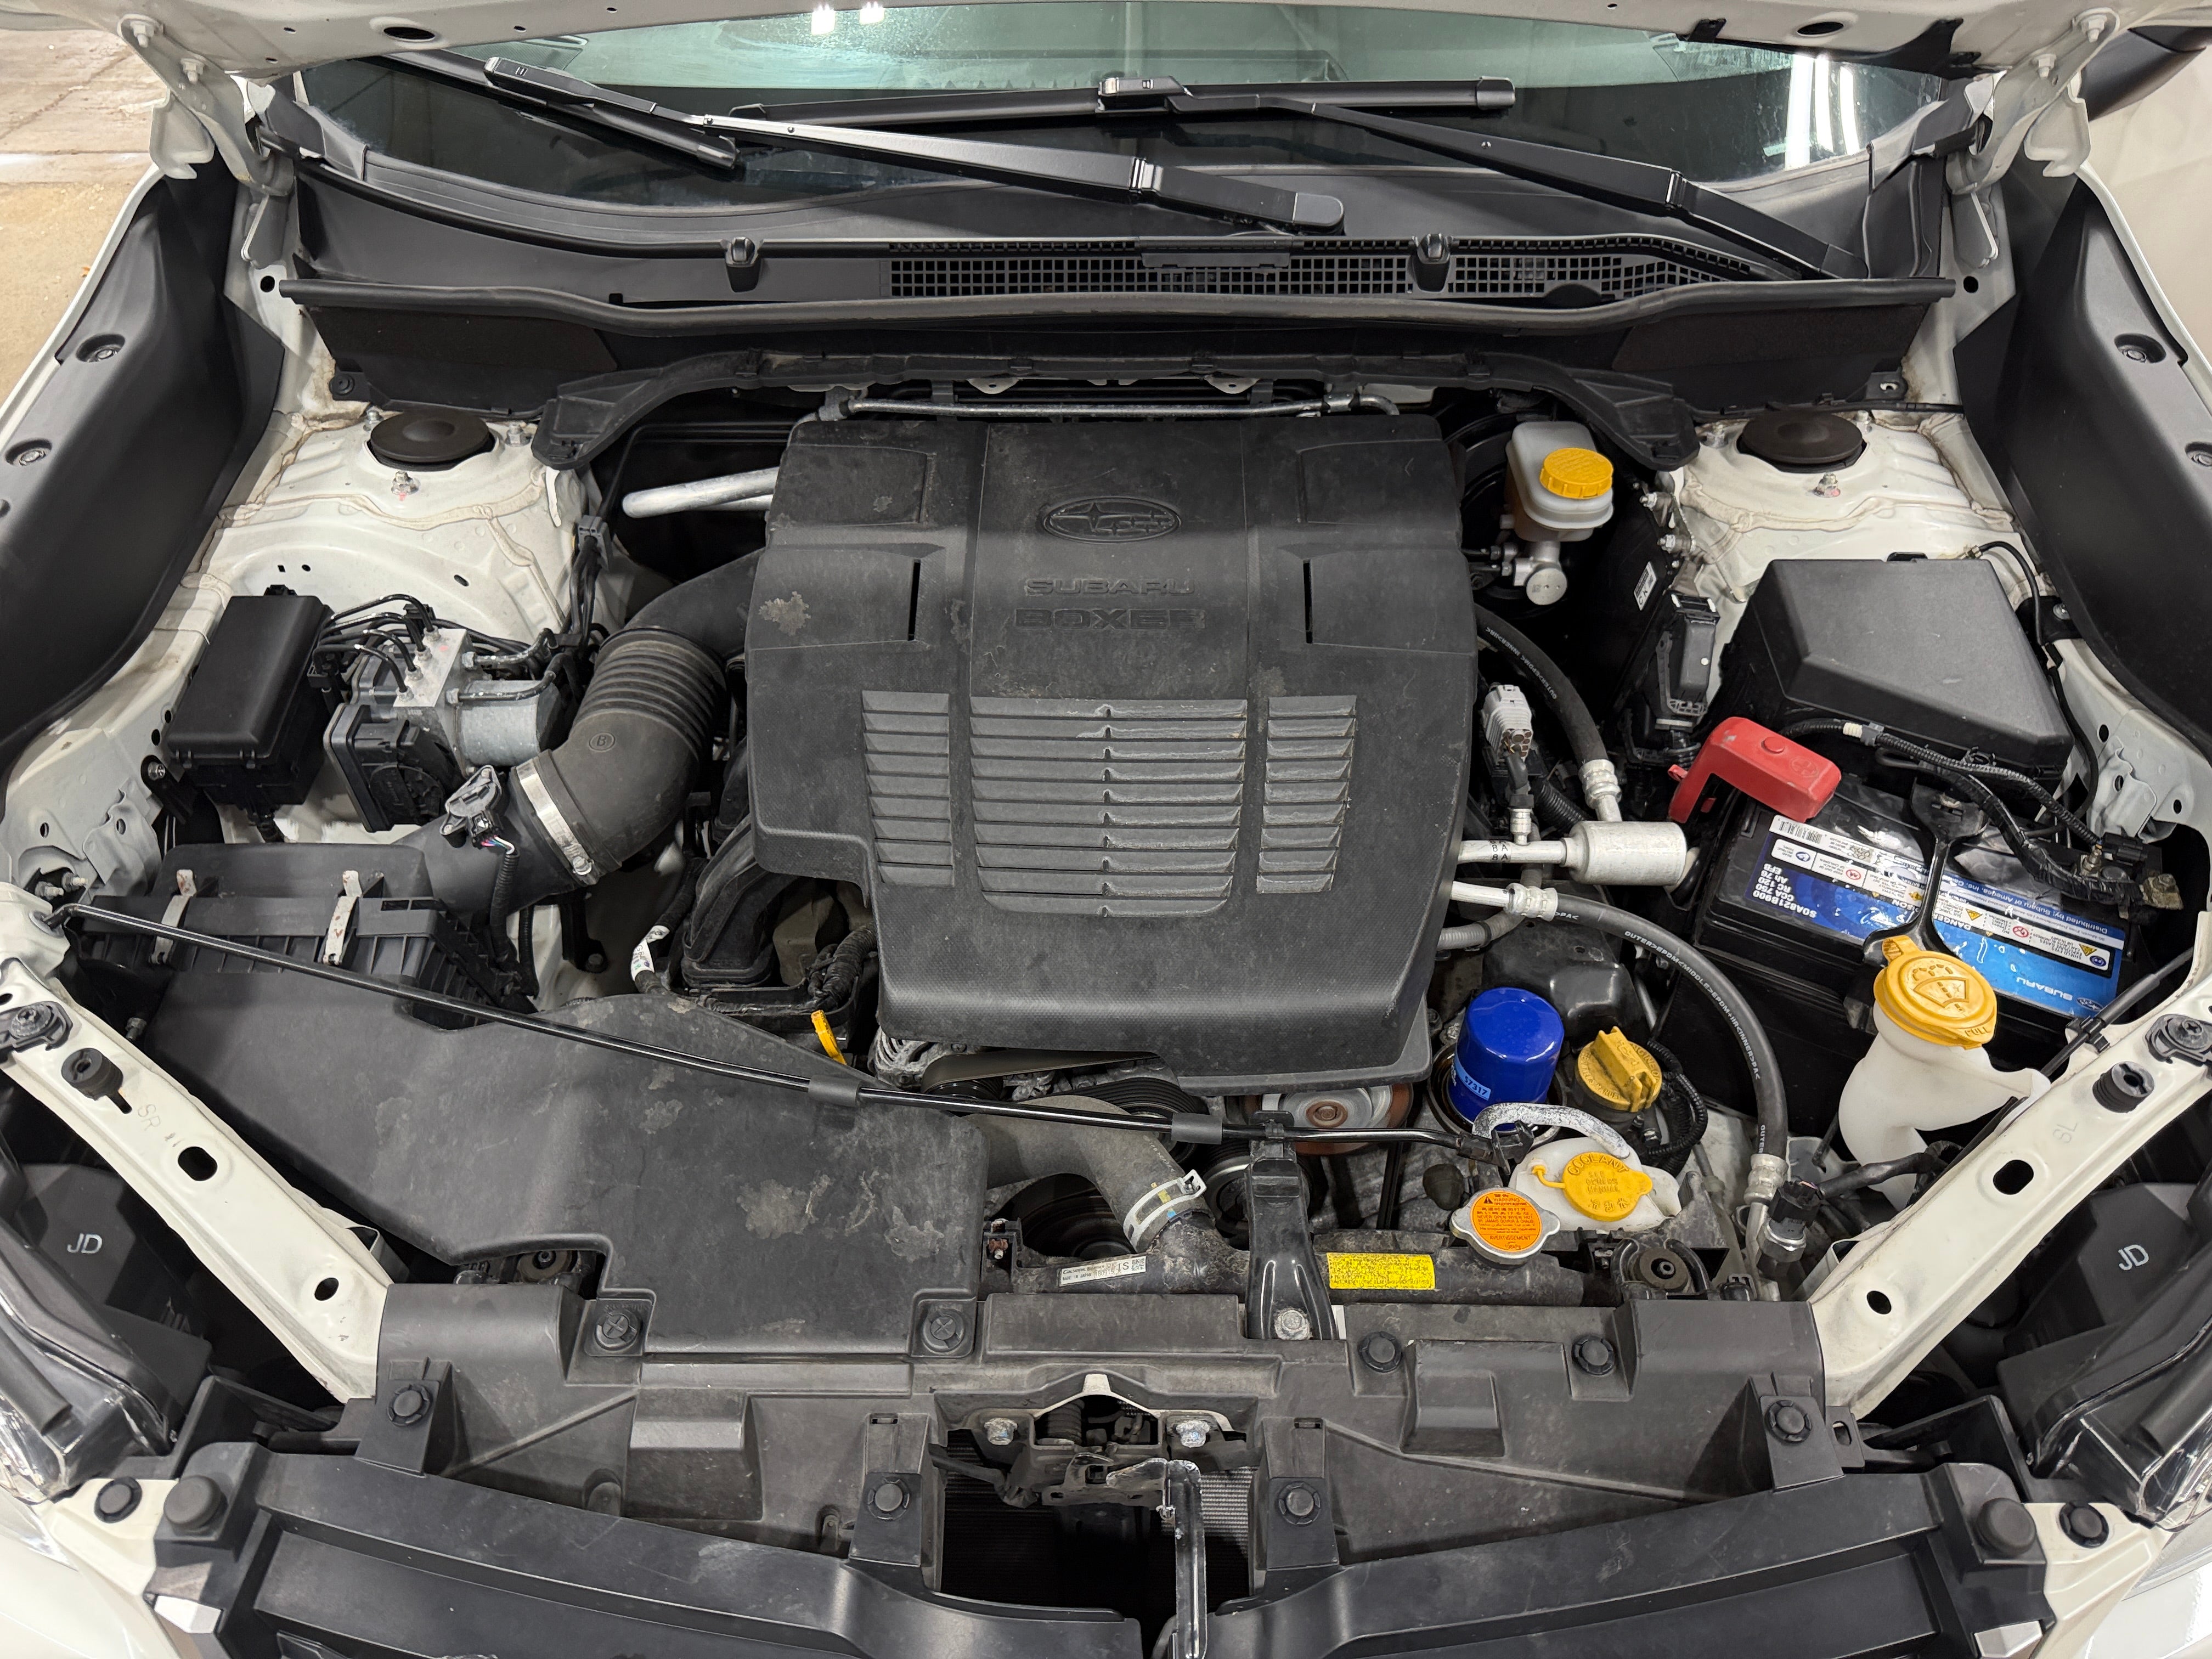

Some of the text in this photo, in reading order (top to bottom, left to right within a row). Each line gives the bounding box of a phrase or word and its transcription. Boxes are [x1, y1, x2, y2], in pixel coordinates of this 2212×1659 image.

[1025, 578, 1195, 595] SUBARU
[1015, 608, 1206, 630] BOXER
[1762, 862, 1782, 876] EFB
[1757, 876, 1792, 894] RC 120
[1773, 873, 1789, 885] Ah
[1754, 882, 1795, 902] CCA 750
[2023, 901, 2051, 915] Subaru
[2065, 915, 2108, 934] Distributed
[2015, 976, 2074, 1001] SUBARU
[1567, 1154, 1629, 1176] COOLANT
[67, 1233, 103, 1254] JD
[2118, 1244, 2149, 1271] JD
